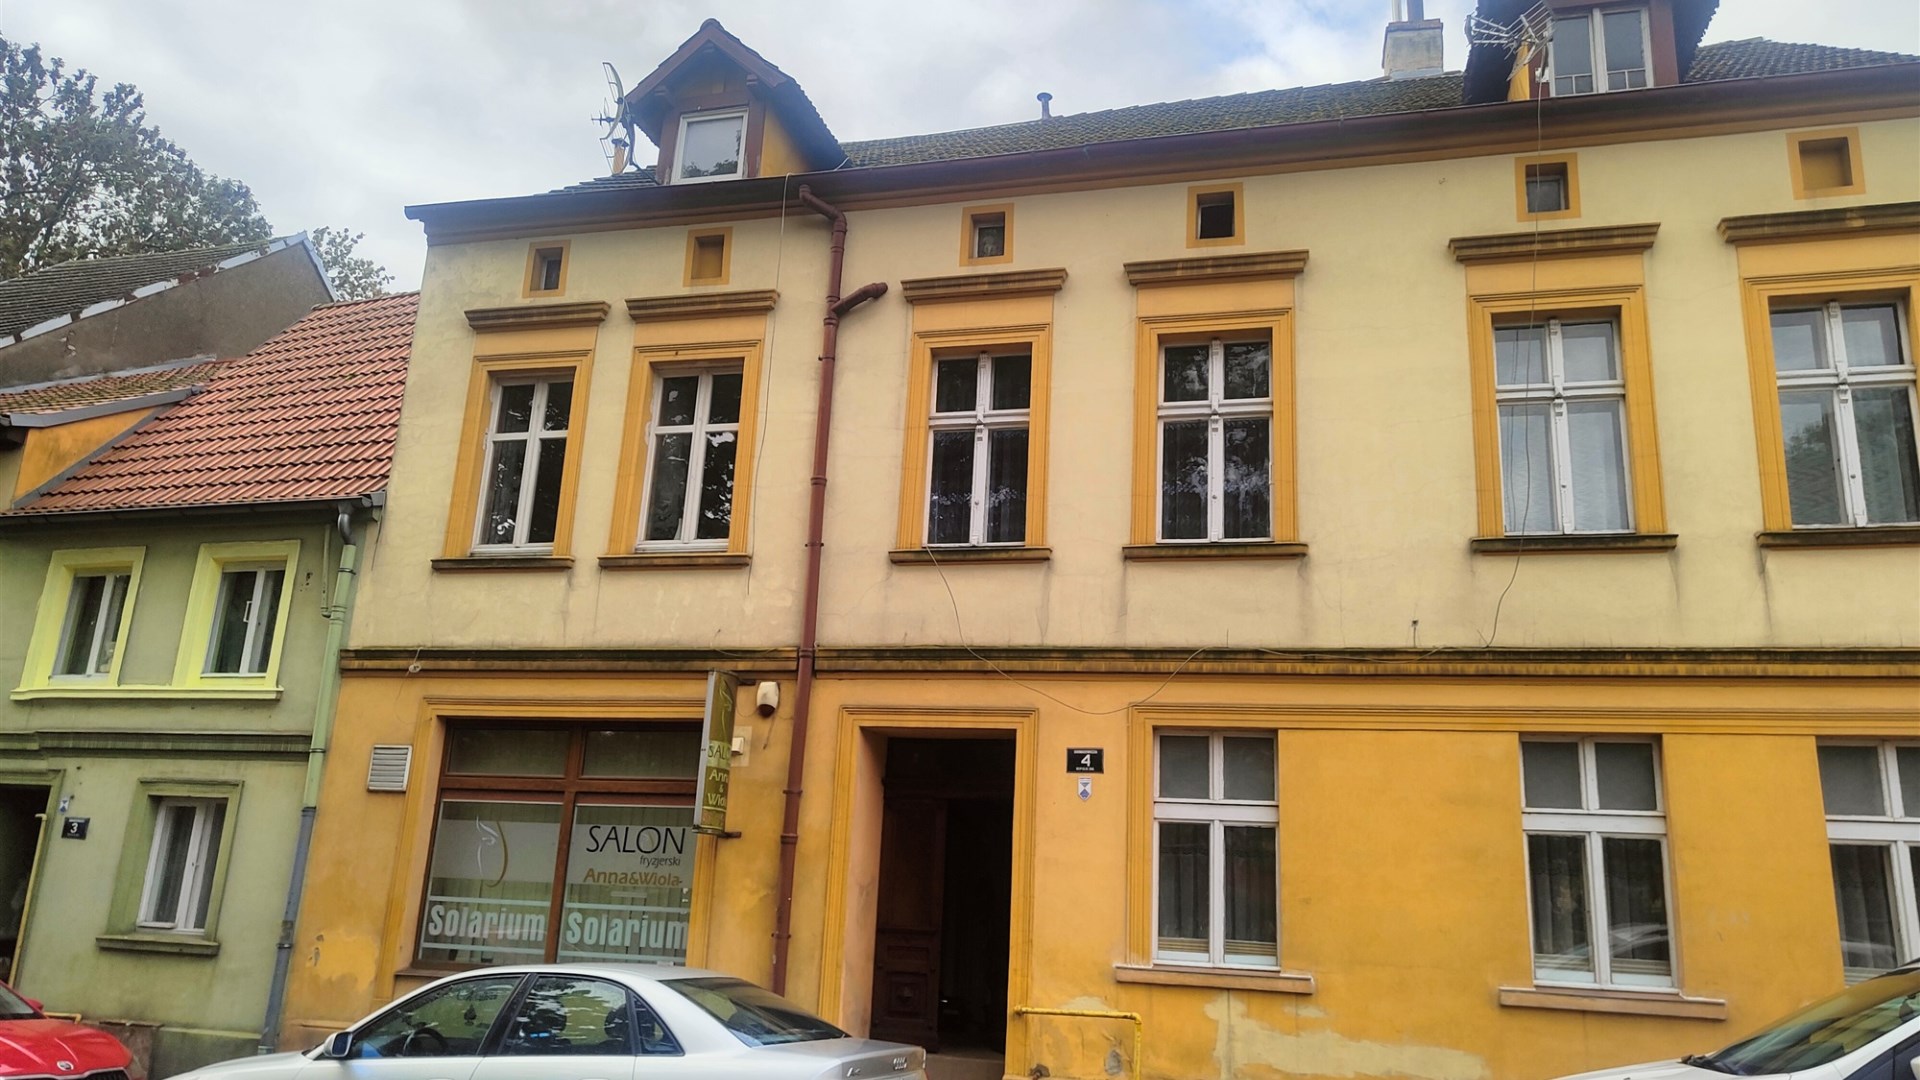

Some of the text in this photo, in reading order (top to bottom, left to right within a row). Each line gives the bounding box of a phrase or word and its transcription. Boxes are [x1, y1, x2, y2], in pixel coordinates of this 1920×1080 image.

[1080, 753, 1091, 767] 4
[70, 822, 79, 834] 3
[586, 825, 686, 854] SALON
[639, 855, 681, 869] fryzjerski
[428, 904, 547, 942] Solarium
[565, 911, 689, 950] Solarium
